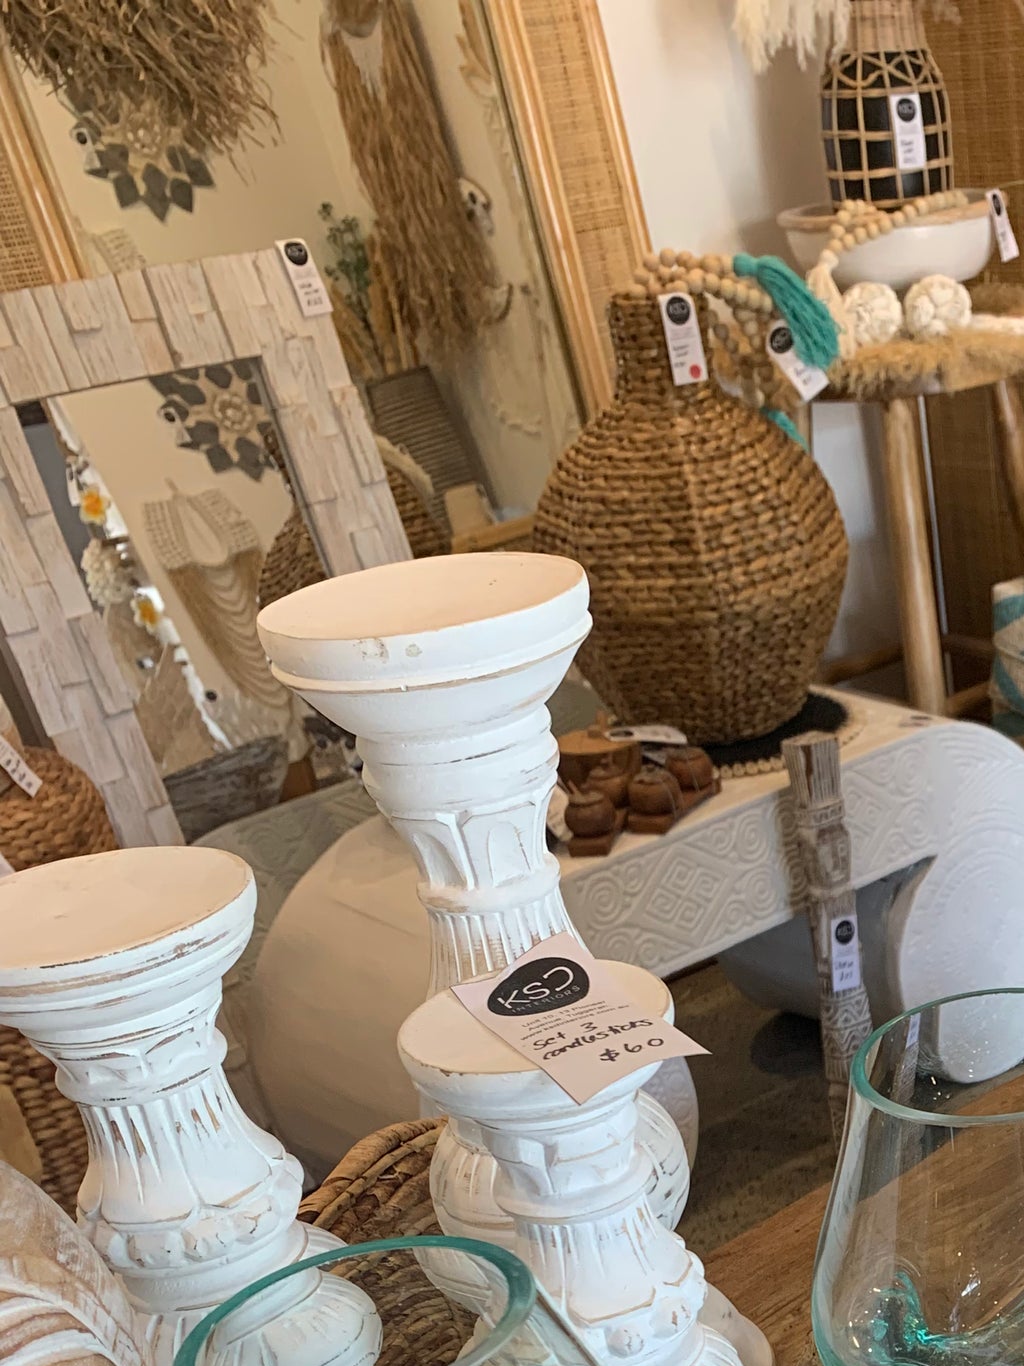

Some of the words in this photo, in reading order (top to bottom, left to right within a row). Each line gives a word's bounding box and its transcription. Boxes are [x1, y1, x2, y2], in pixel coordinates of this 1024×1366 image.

[497, 966, 574, 1009] KSD
[512, 985, 580, 1013] INTERIORS
[580, 1021, 598, 1033] 3
[599, 1037, 664, 1062] $60
